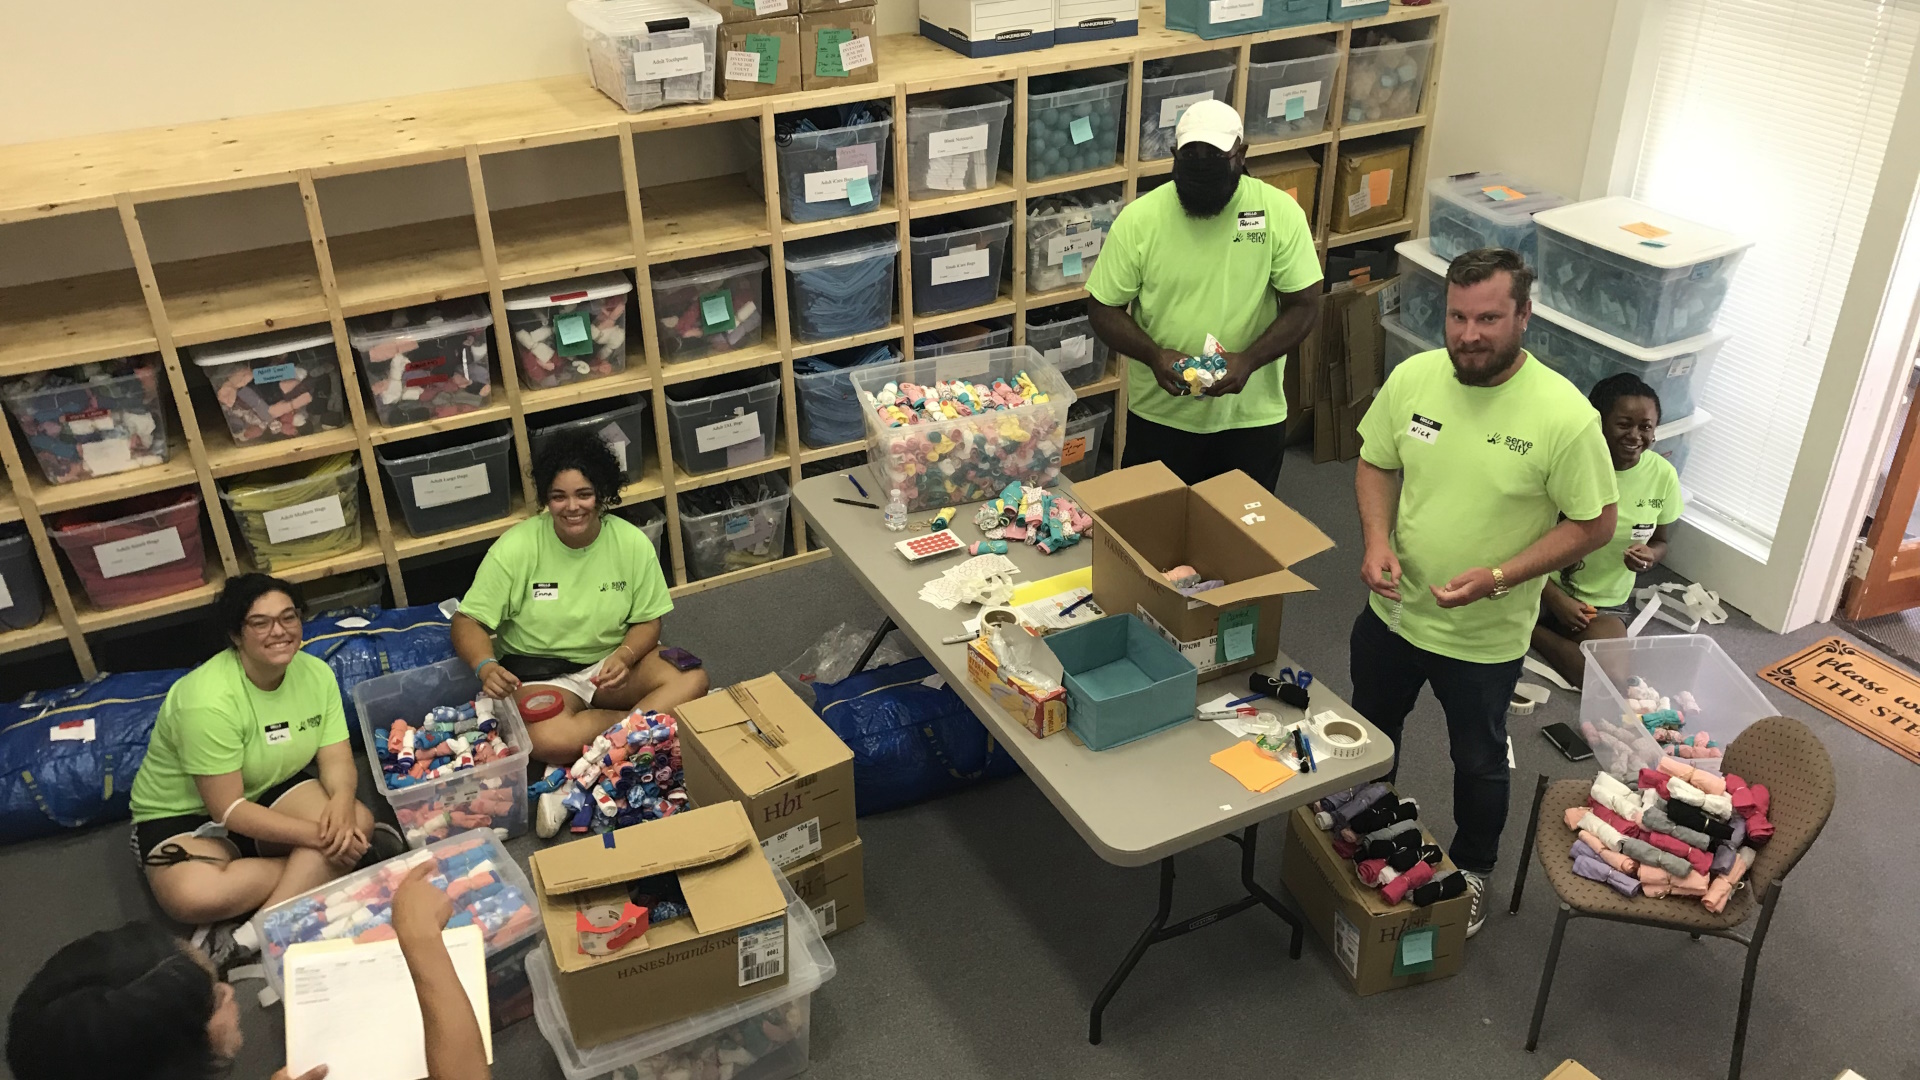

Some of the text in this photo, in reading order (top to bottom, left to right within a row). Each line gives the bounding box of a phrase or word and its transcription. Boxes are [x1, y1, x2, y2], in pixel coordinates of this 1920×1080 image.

[1251, 236, 1266, 245] city
[1420, 416, 1434, 426] HELLO
[1505, 435, 1533, 449] serve
[1508, 442, 1530, 455] city
[1816, 657, 1889, 695] please
[1811, 671, 1920, 737] THE STE
